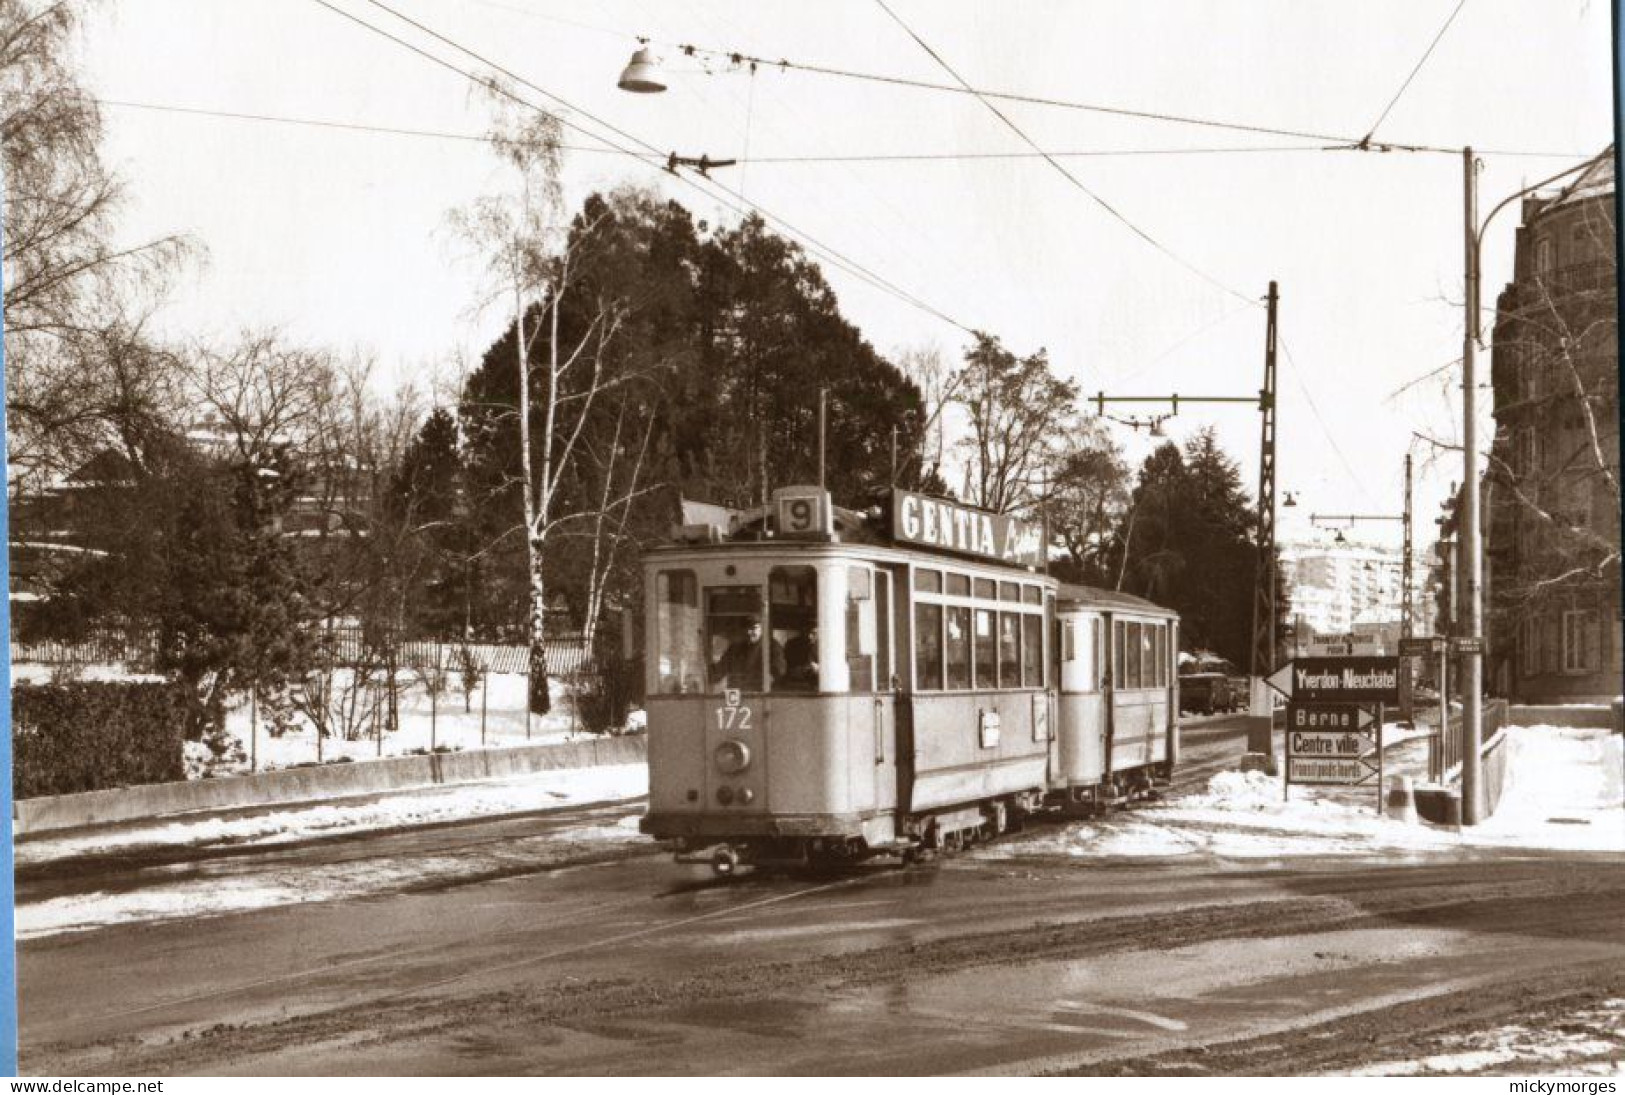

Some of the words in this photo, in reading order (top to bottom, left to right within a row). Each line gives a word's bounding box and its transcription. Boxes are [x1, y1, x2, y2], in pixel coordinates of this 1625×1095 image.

[791, 500, 811, 530] 9
[902, 495, 996, 556] GENTIA
[715, 706, 752, 729] 172
[1296, 708, 1349, 726] Berne
[1294, 733, 1332, 752] Centre
[1335, 733, 1359, 753] ville
